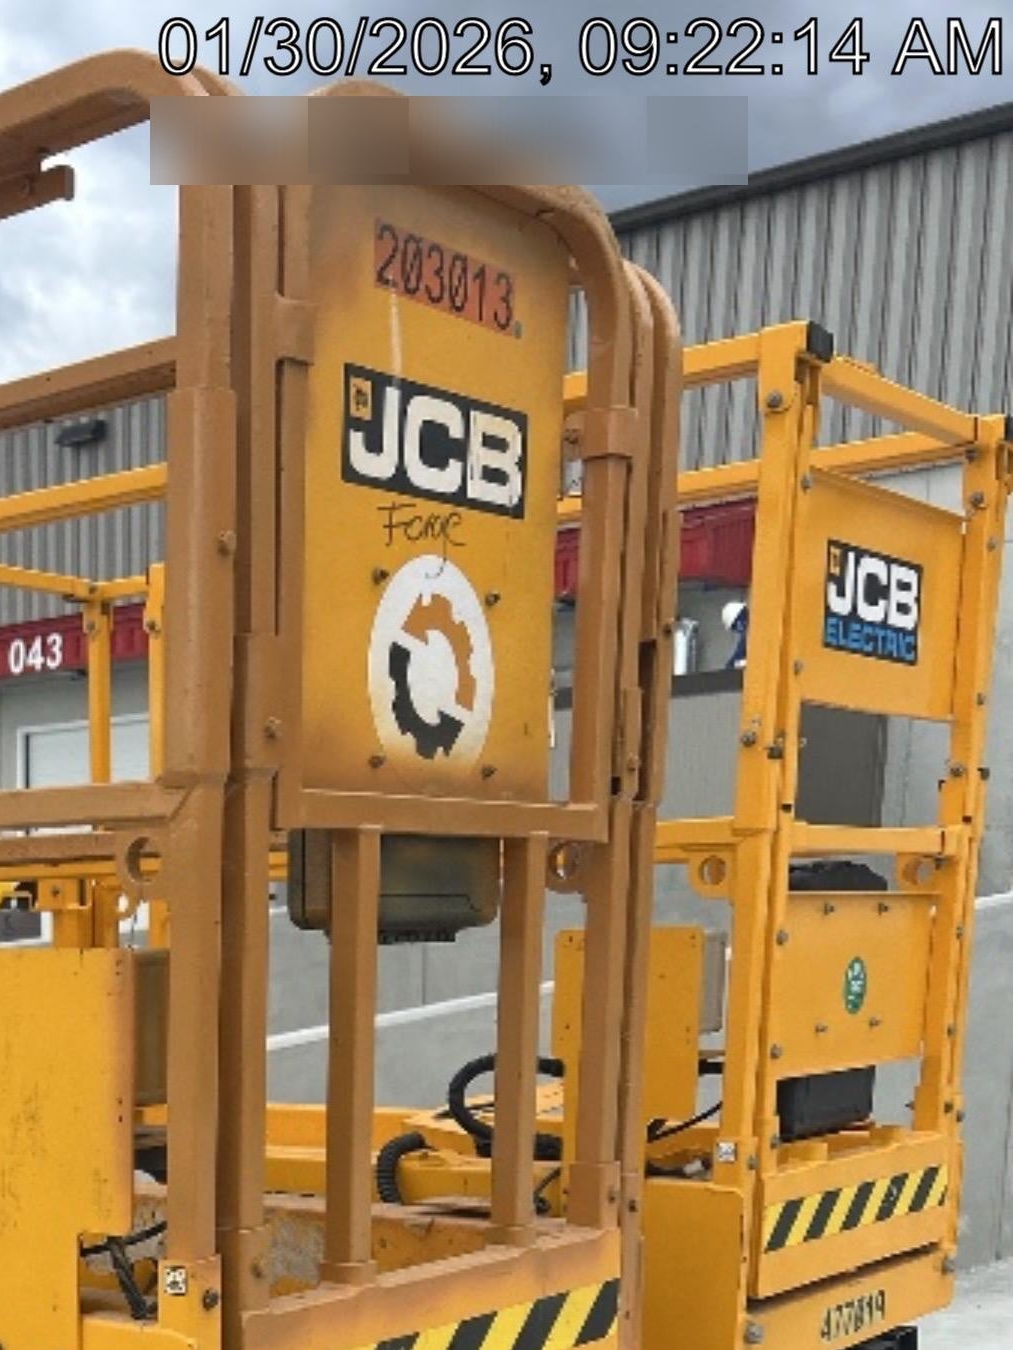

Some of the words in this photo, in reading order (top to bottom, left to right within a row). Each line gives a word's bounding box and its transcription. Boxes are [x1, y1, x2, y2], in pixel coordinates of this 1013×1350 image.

[376, 223, 514, 331] 203013
[348, 385, 523, 508] JCB
[826, 550, 919, 631] JCB
[7, 632, 63, 675] 043
[824, 616, 917, 661] ELECTRIC
